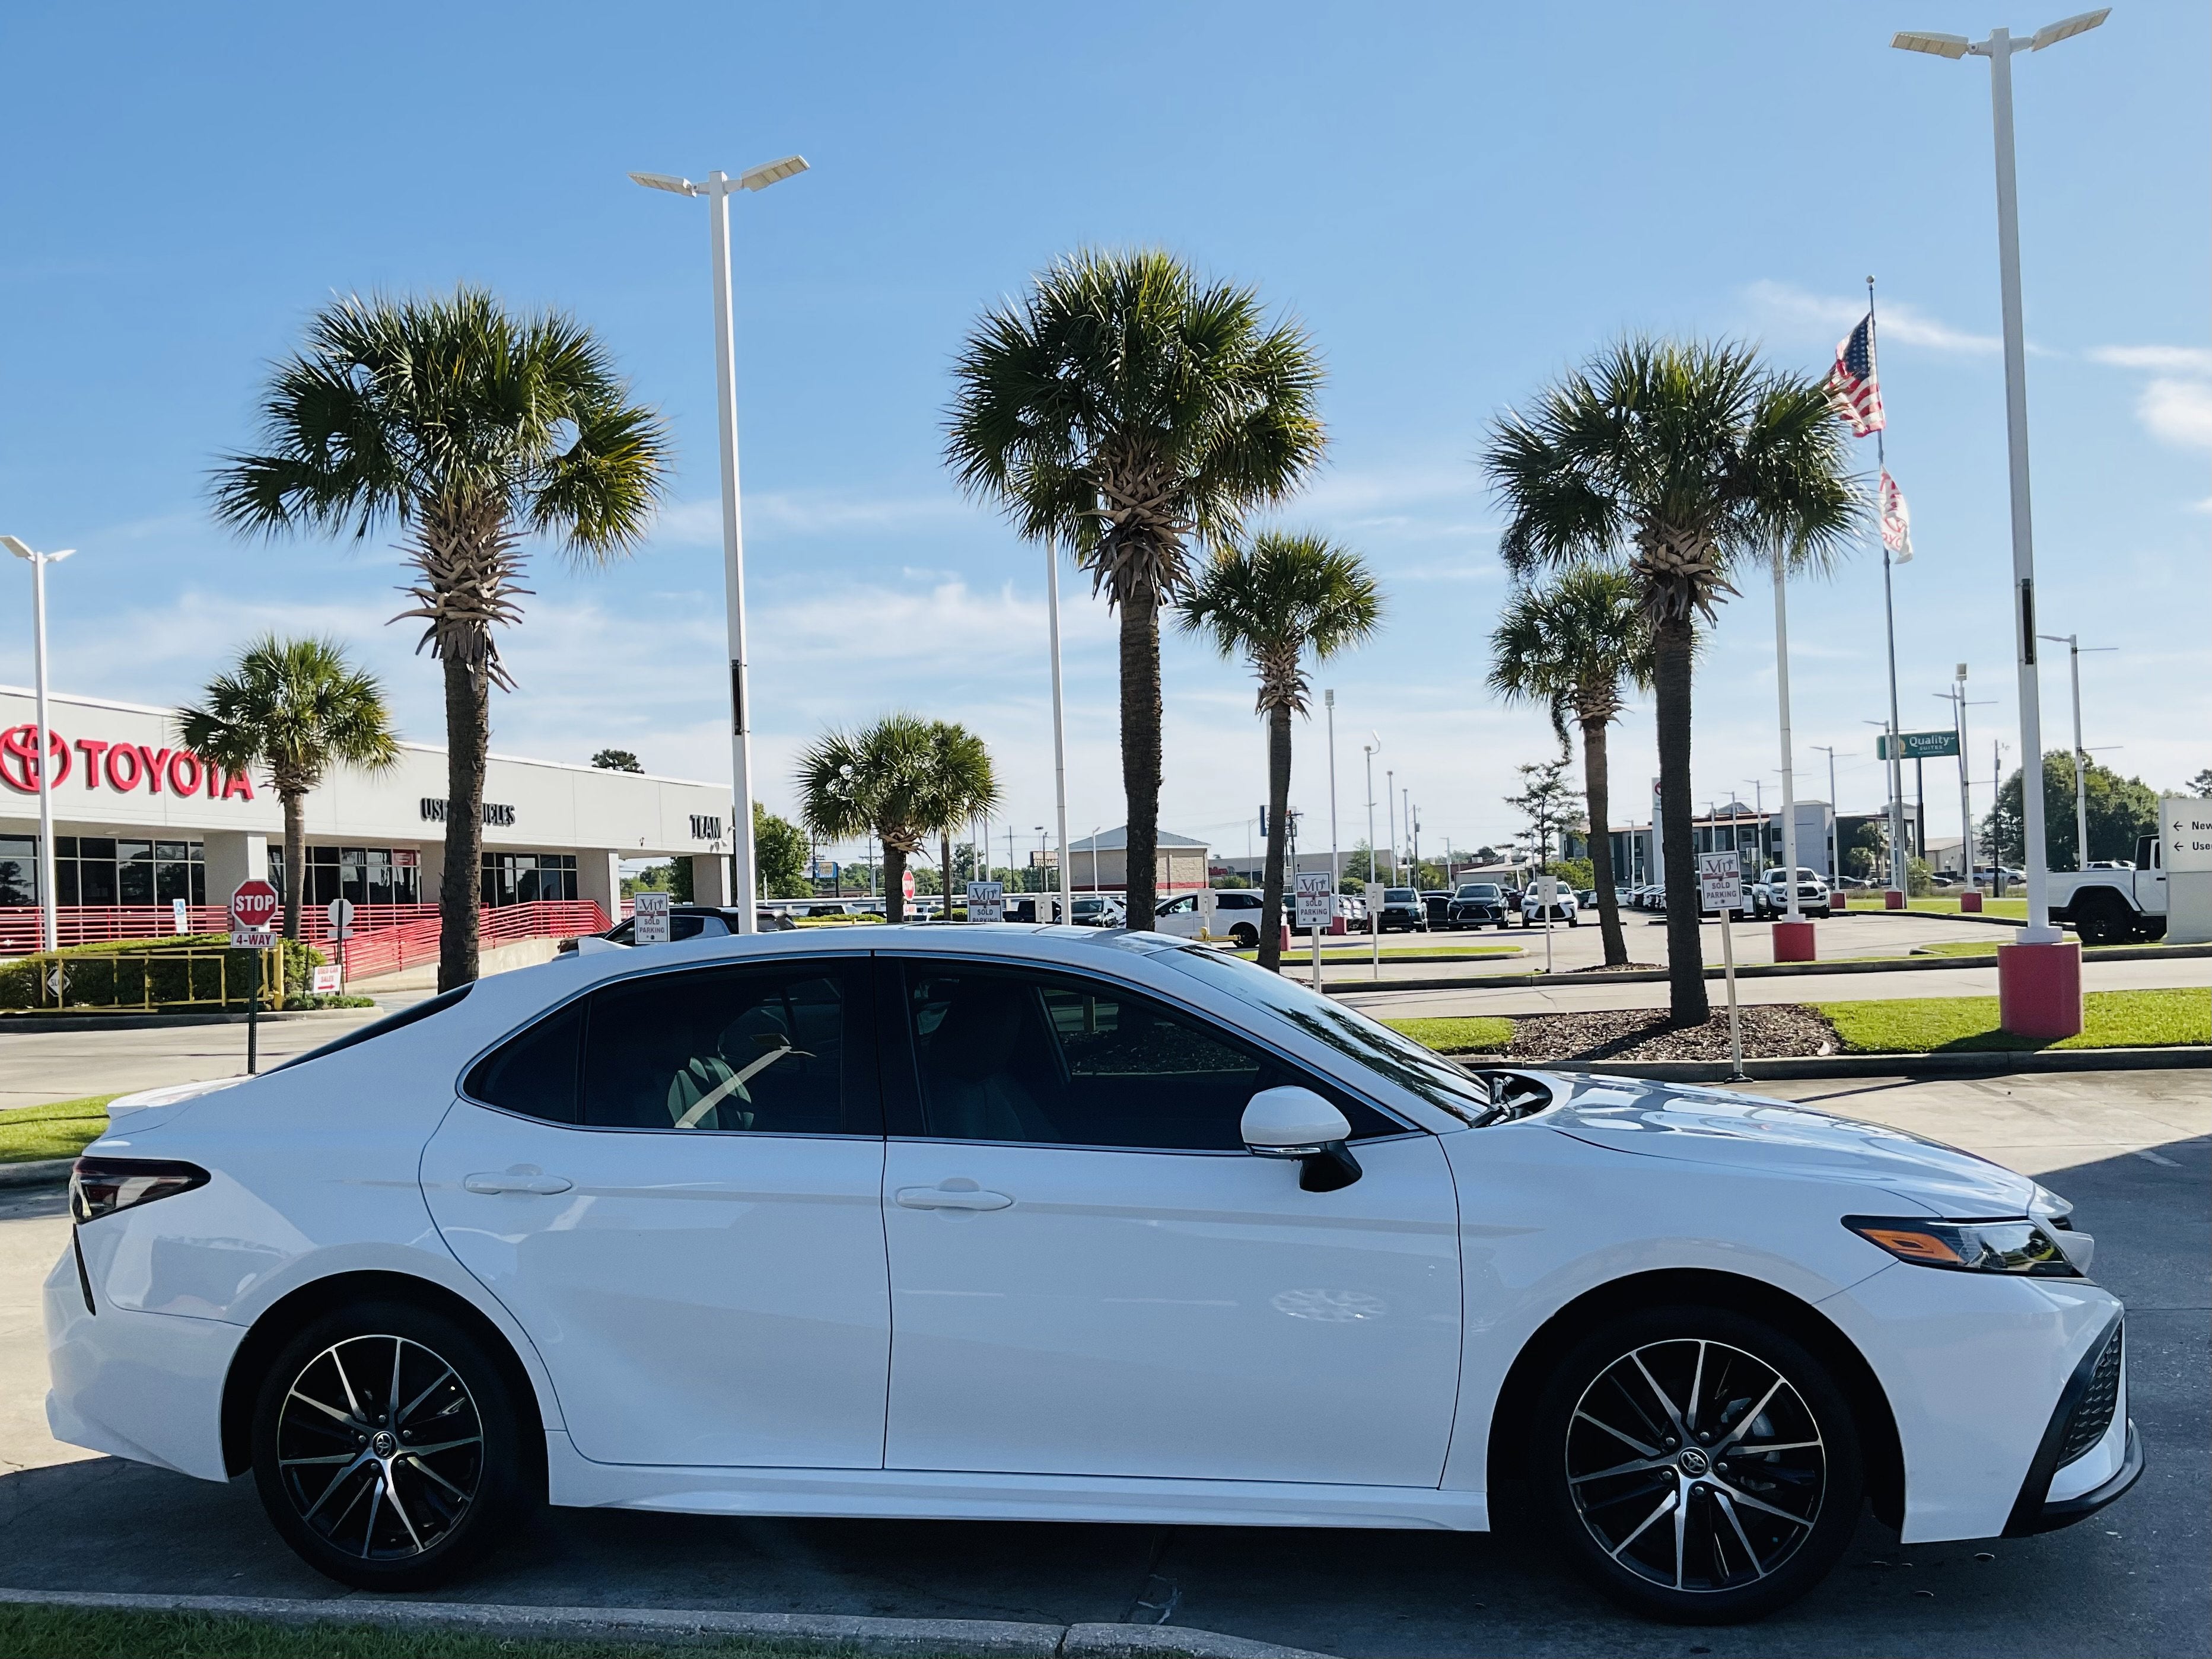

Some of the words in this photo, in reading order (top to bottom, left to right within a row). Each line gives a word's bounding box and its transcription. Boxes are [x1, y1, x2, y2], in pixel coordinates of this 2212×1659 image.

[1909, 735, 1950, 747] Quality
[421, 798, 448, 821] USE
[689, 815, 721, 840] TEAM
[2192, 842, 2212, 851] Use
[903, 880, 914, 890] STOP
[235, 894, 274, 912] STOP
[236, 934, 271, 945] 4-WAY
